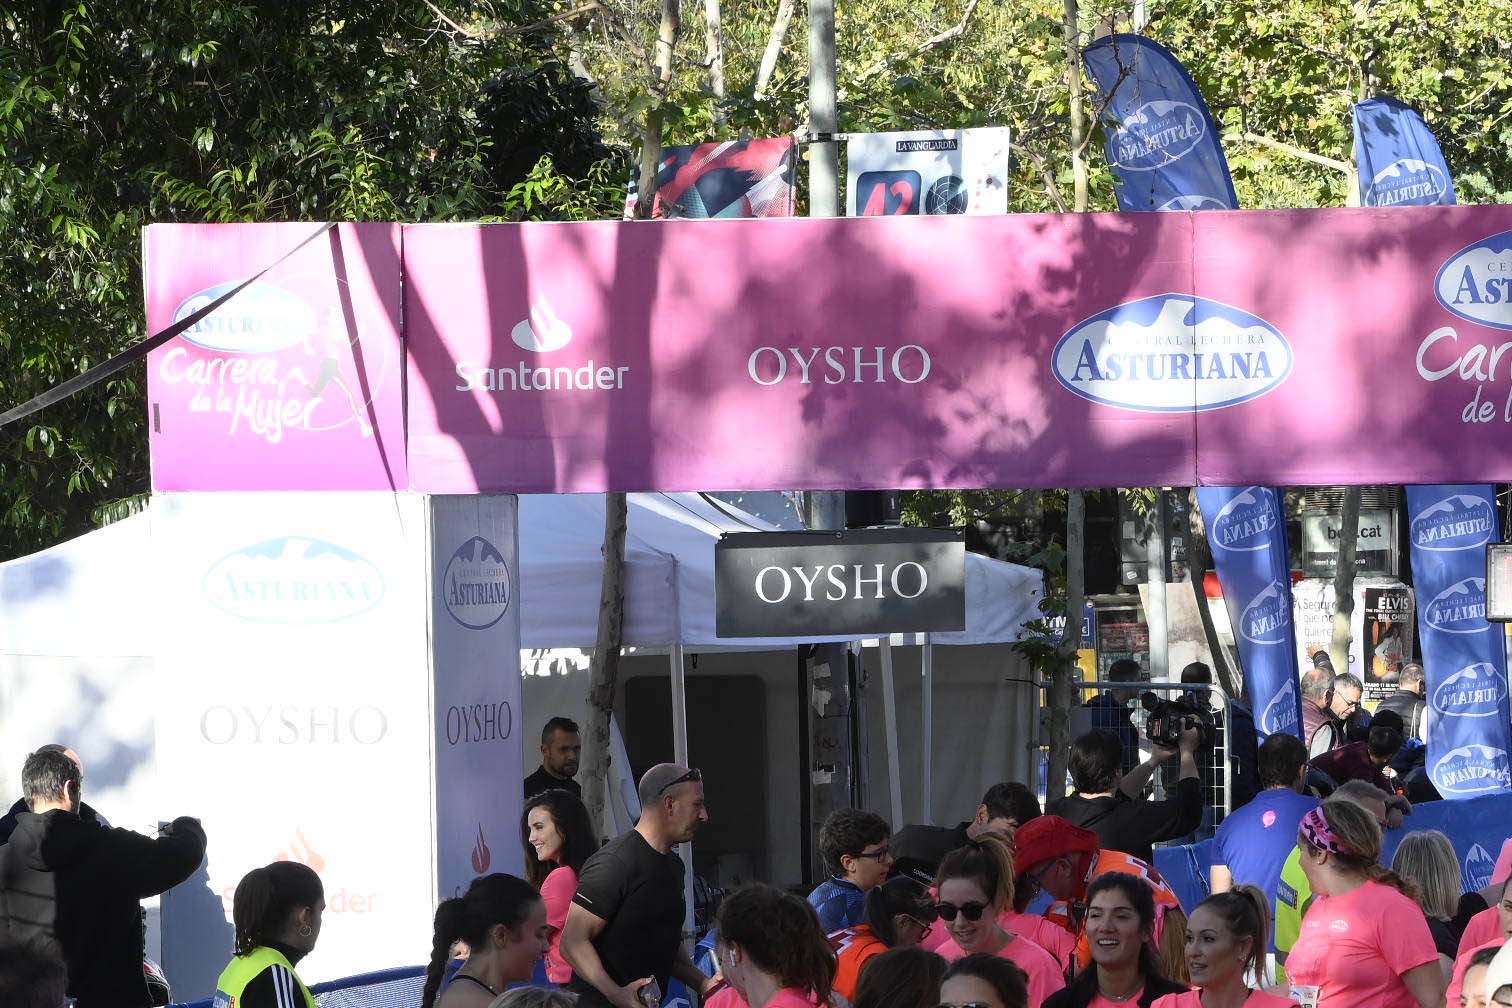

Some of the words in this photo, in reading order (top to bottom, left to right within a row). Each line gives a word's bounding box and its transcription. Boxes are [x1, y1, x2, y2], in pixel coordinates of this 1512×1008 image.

[455, 359, 630, 392] Santander
[748, 345, 932, 386] OYSHO
[1070, 339, 1275, 382] ASTURIANA
[1462, 384, 1496, 424] de
[449, 579, 507, 606] ASTURIANA
[753, 562, 930, 604] OYSHO
[1378, 596, 1409, 609] ELVIS
[199, 704, 389, 746] OYSHO
[446, 702, 512, 746] OYSHO
